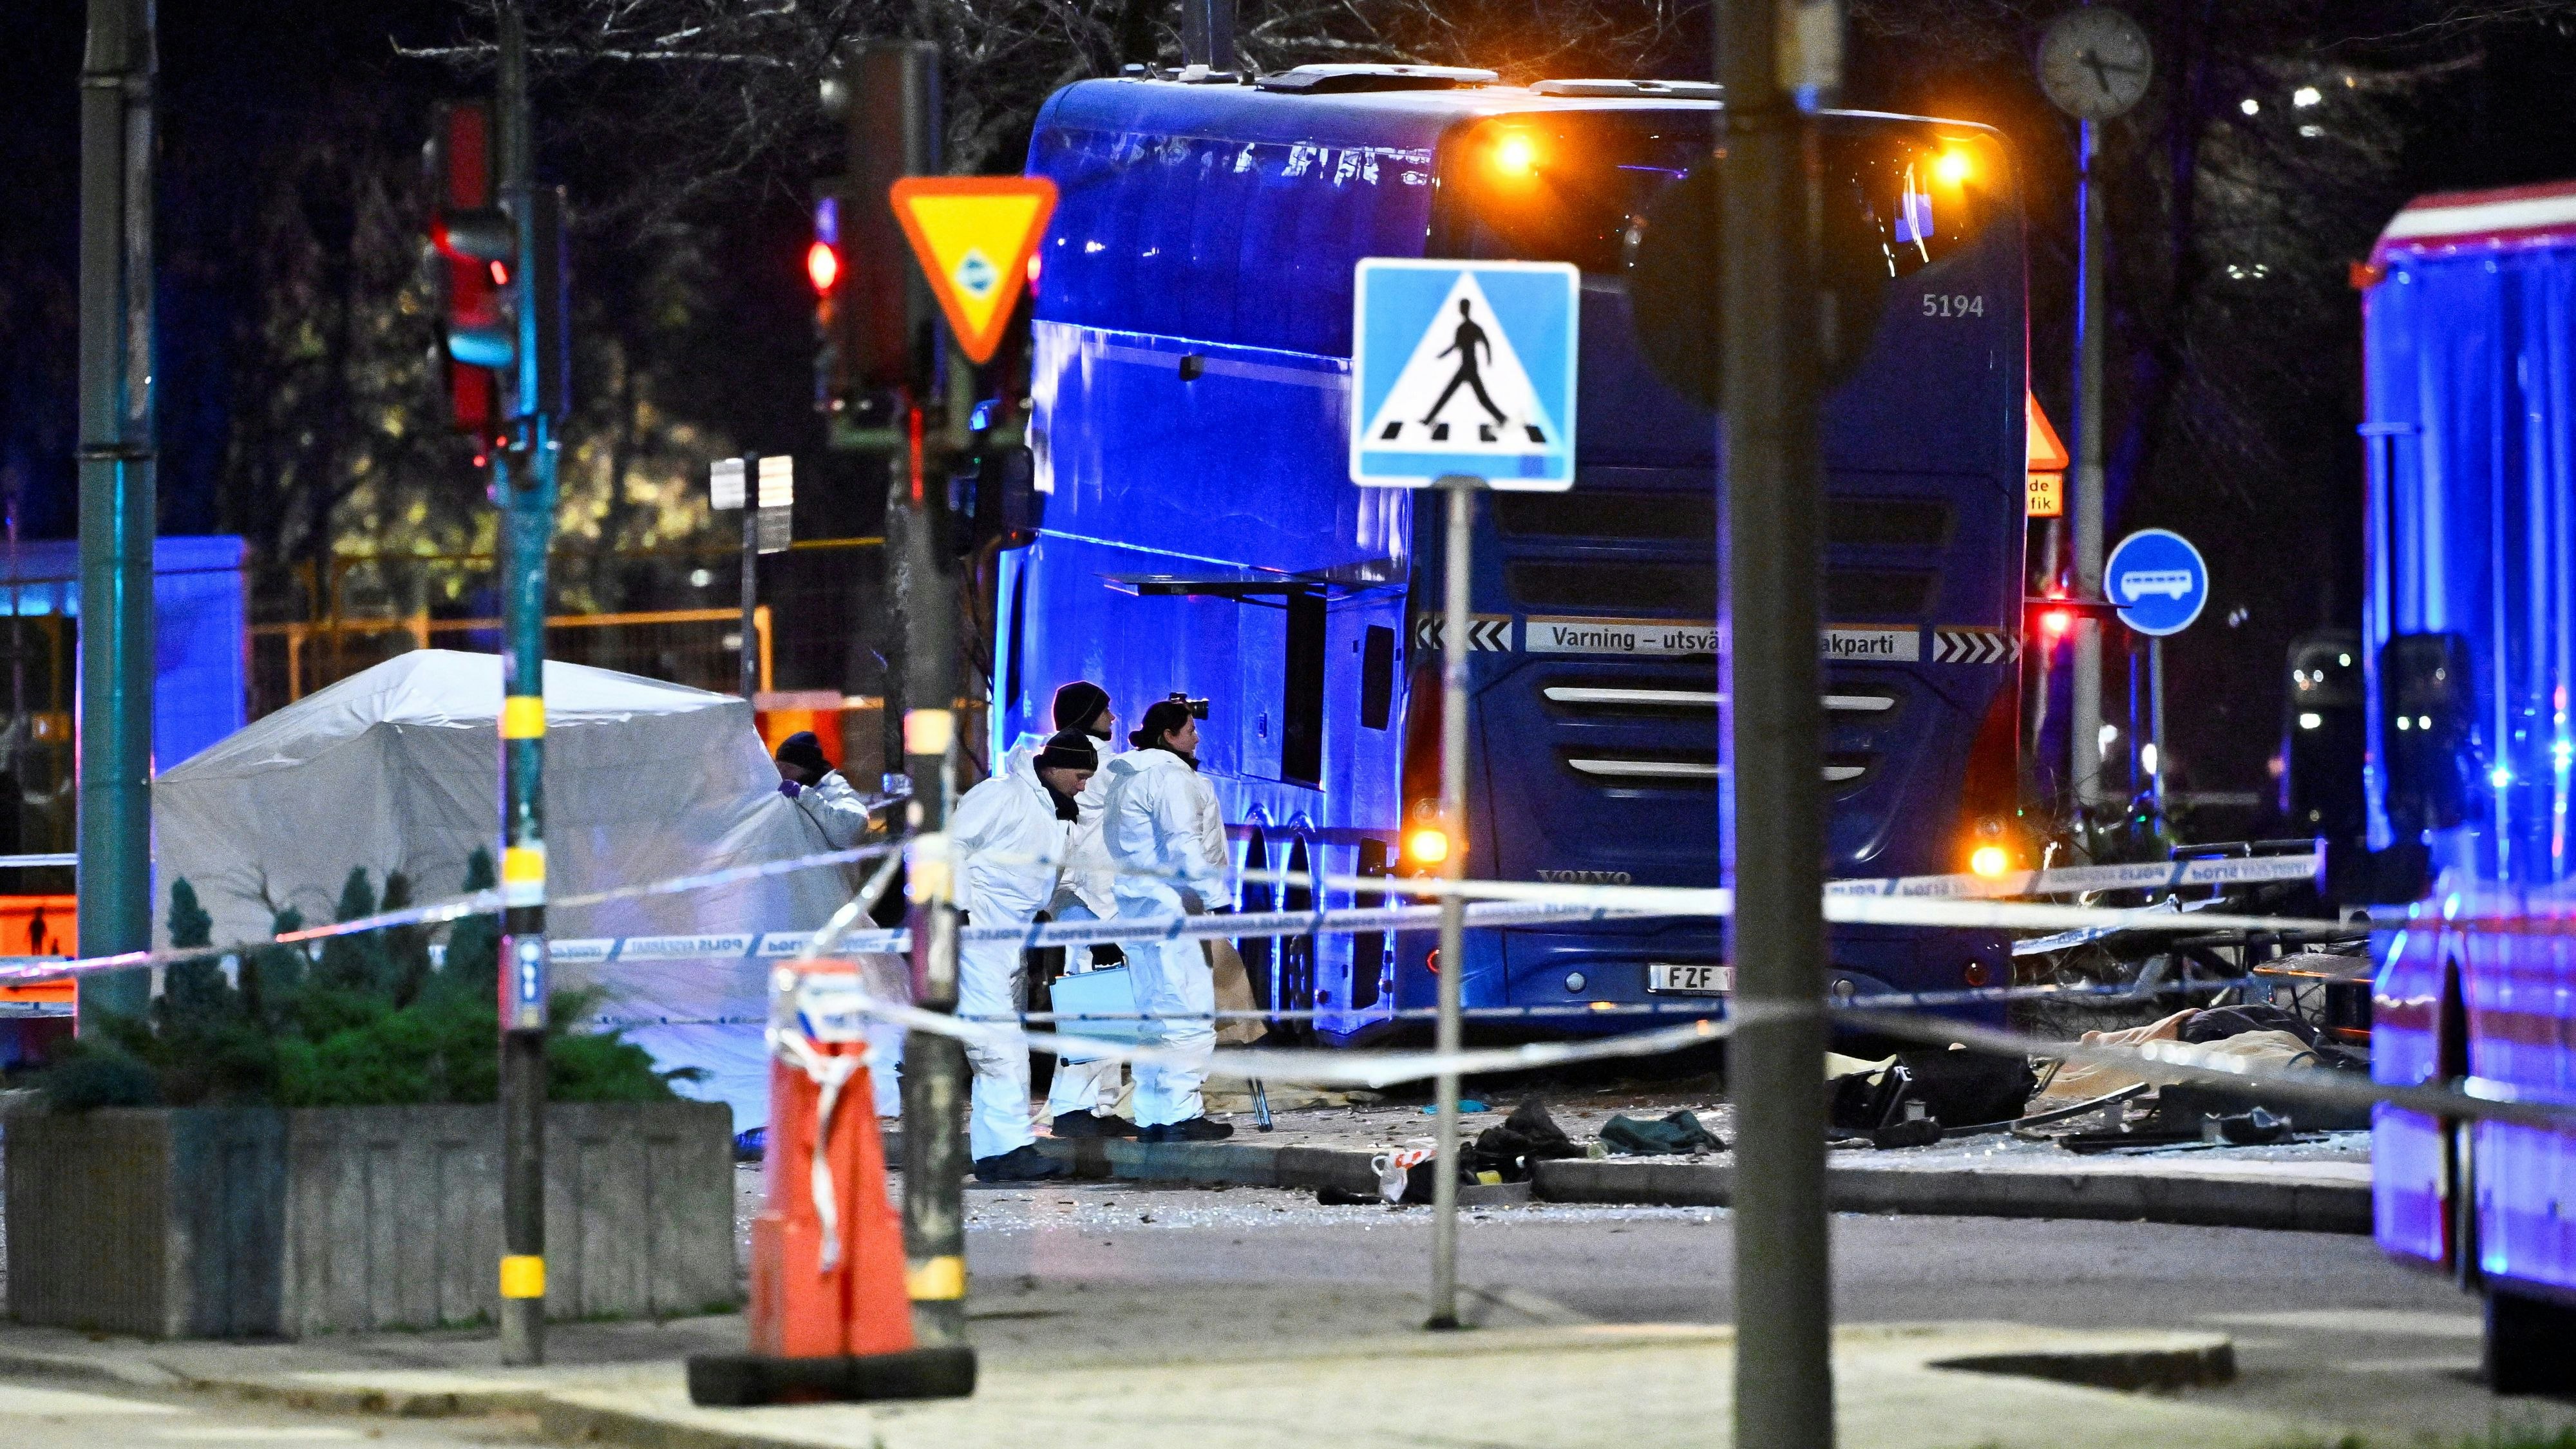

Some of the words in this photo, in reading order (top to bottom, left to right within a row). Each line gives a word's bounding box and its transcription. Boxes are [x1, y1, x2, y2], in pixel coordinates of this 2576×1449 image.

[1922, 294, 1984, 318] 5194
[2029, 479, 2049, 491] de
[2031, 496, 2051, 509] fik
[1553, 626, 1635, 652] Varning
[1663, 630, 1719, 649] utsvä
[1822, 633, 1893, 657] akparti
[1669, 967, 1713, 989] FZF
